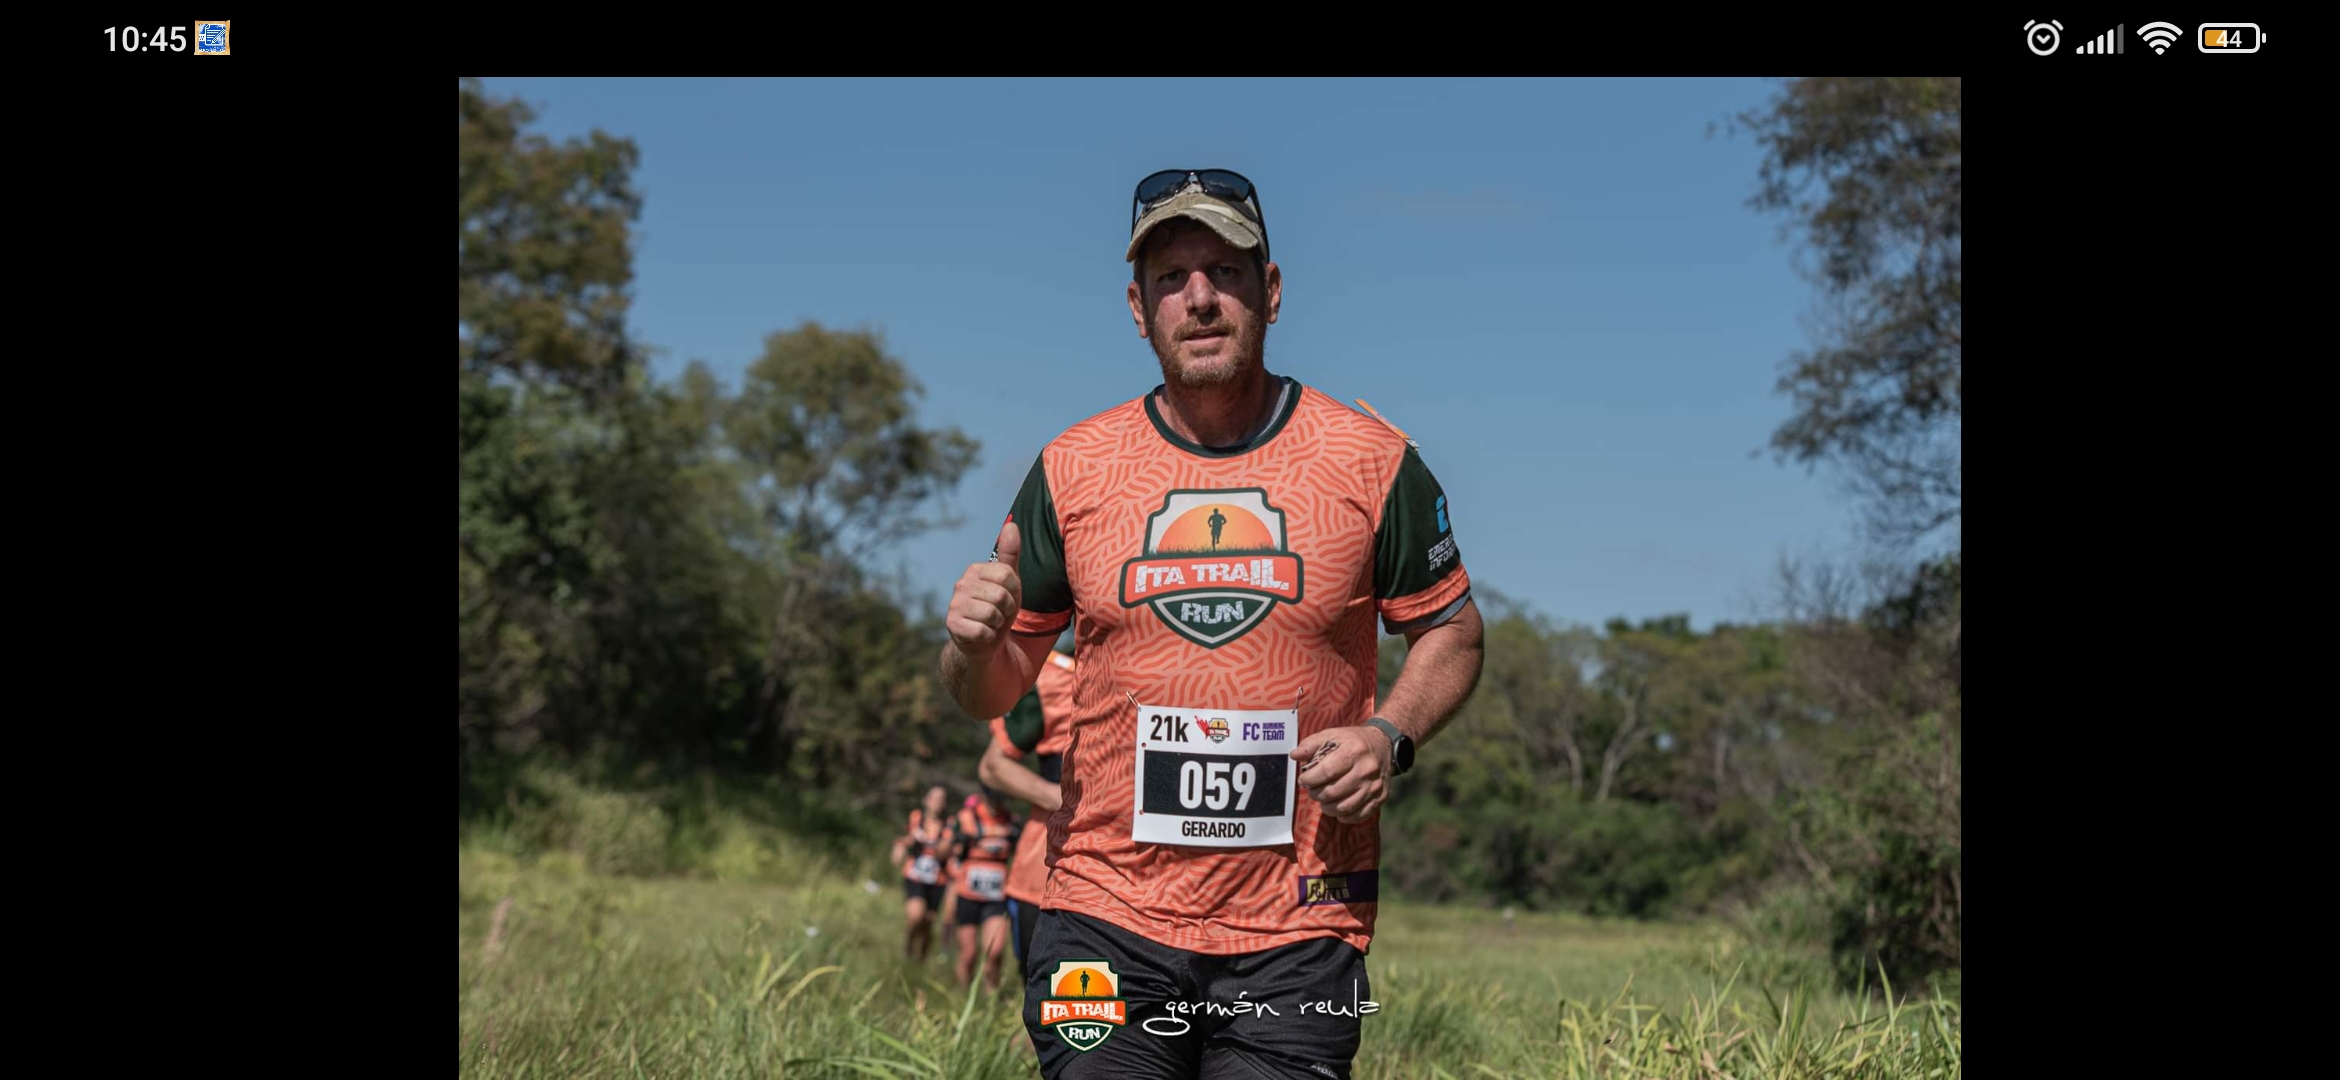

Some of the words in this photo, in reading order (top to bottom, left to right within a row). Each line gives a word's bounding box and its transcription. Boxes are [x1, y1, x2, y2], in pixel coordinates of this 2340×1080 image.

[1134, 565, 1186, 594] ITA
[1191, 558, 1290, 591] TRAIL
[1180, 601, 1245, 625] RUN
[1150, 714, 1189, 742] 21k
[1242, 722, 1260, 741] FC
[1262, 730, 1285, 741] TEAM
[1179, 760, 1256, 811] 059
[1182, 820, 1246, 838] GERARDO
